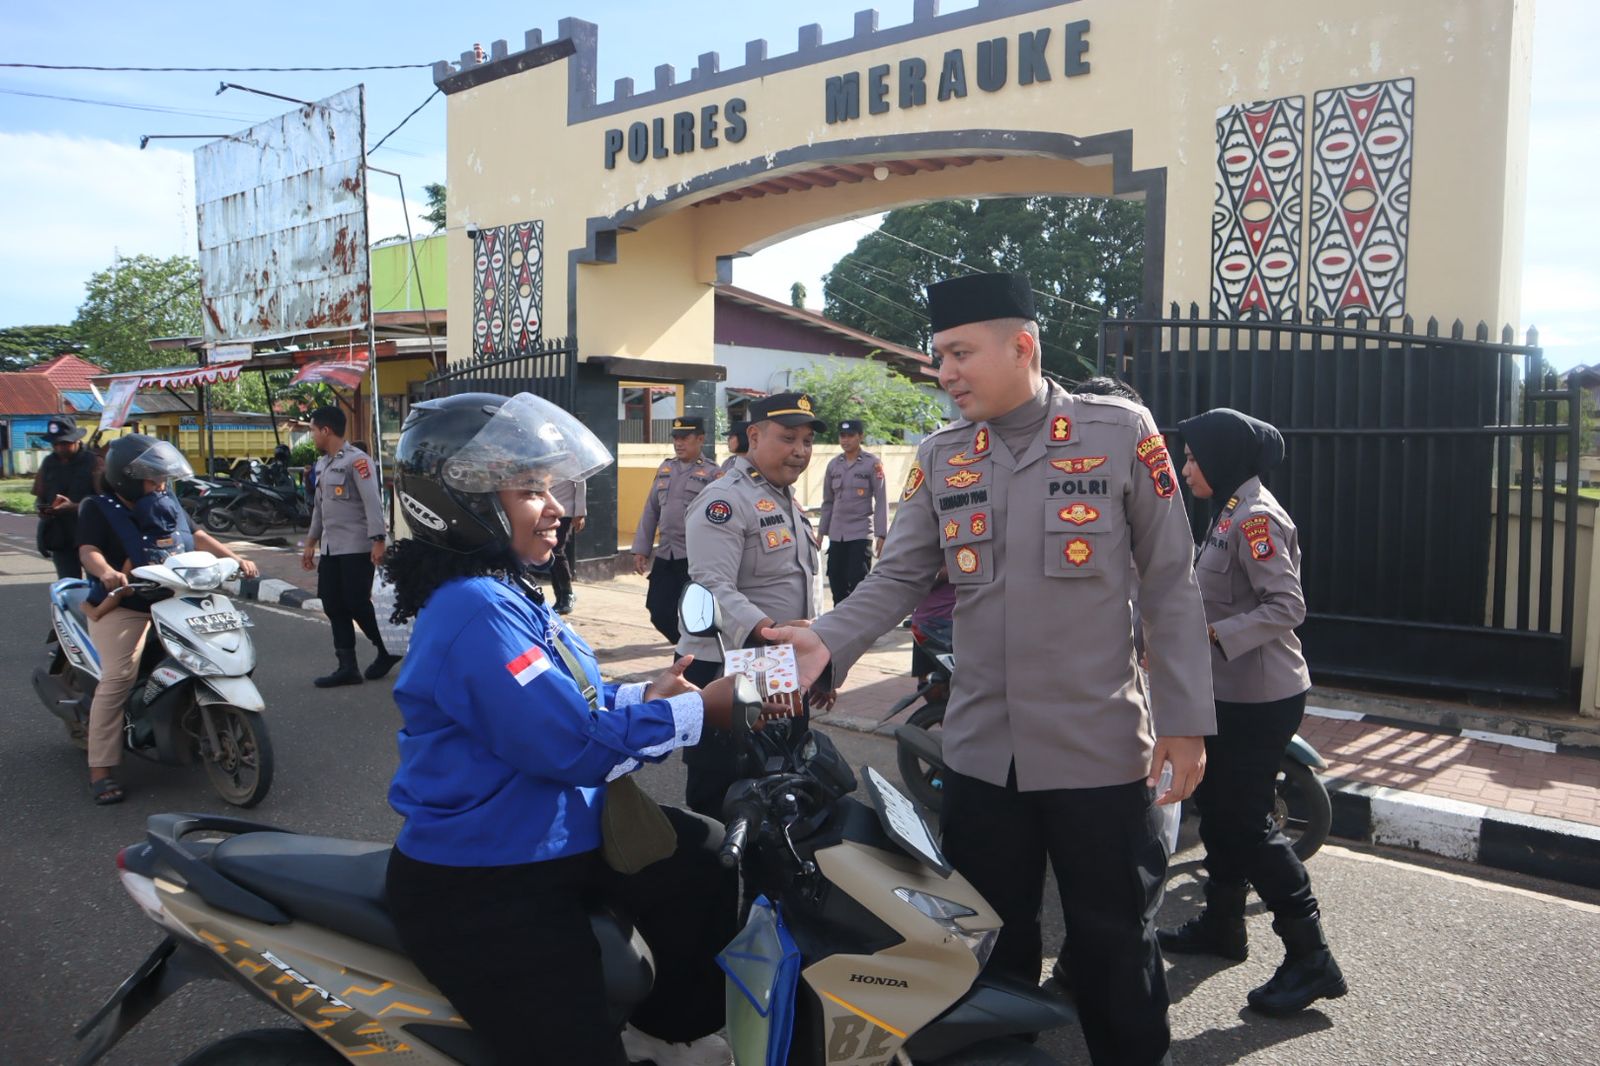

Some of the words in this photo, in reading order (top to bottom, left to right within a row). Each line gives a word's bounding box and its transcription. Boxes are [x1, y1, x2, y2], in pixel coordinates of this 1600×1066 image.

[604, 97, 748, 170] POLRES
[825, 19, 1091, 125] MERAUKE
[1049, 479, 1107, 496] POLRI
[403, 496, 442, 526] INK
[760, 514, 785, 528] ANDRE
[849, 973, 909, 989] HONDA
